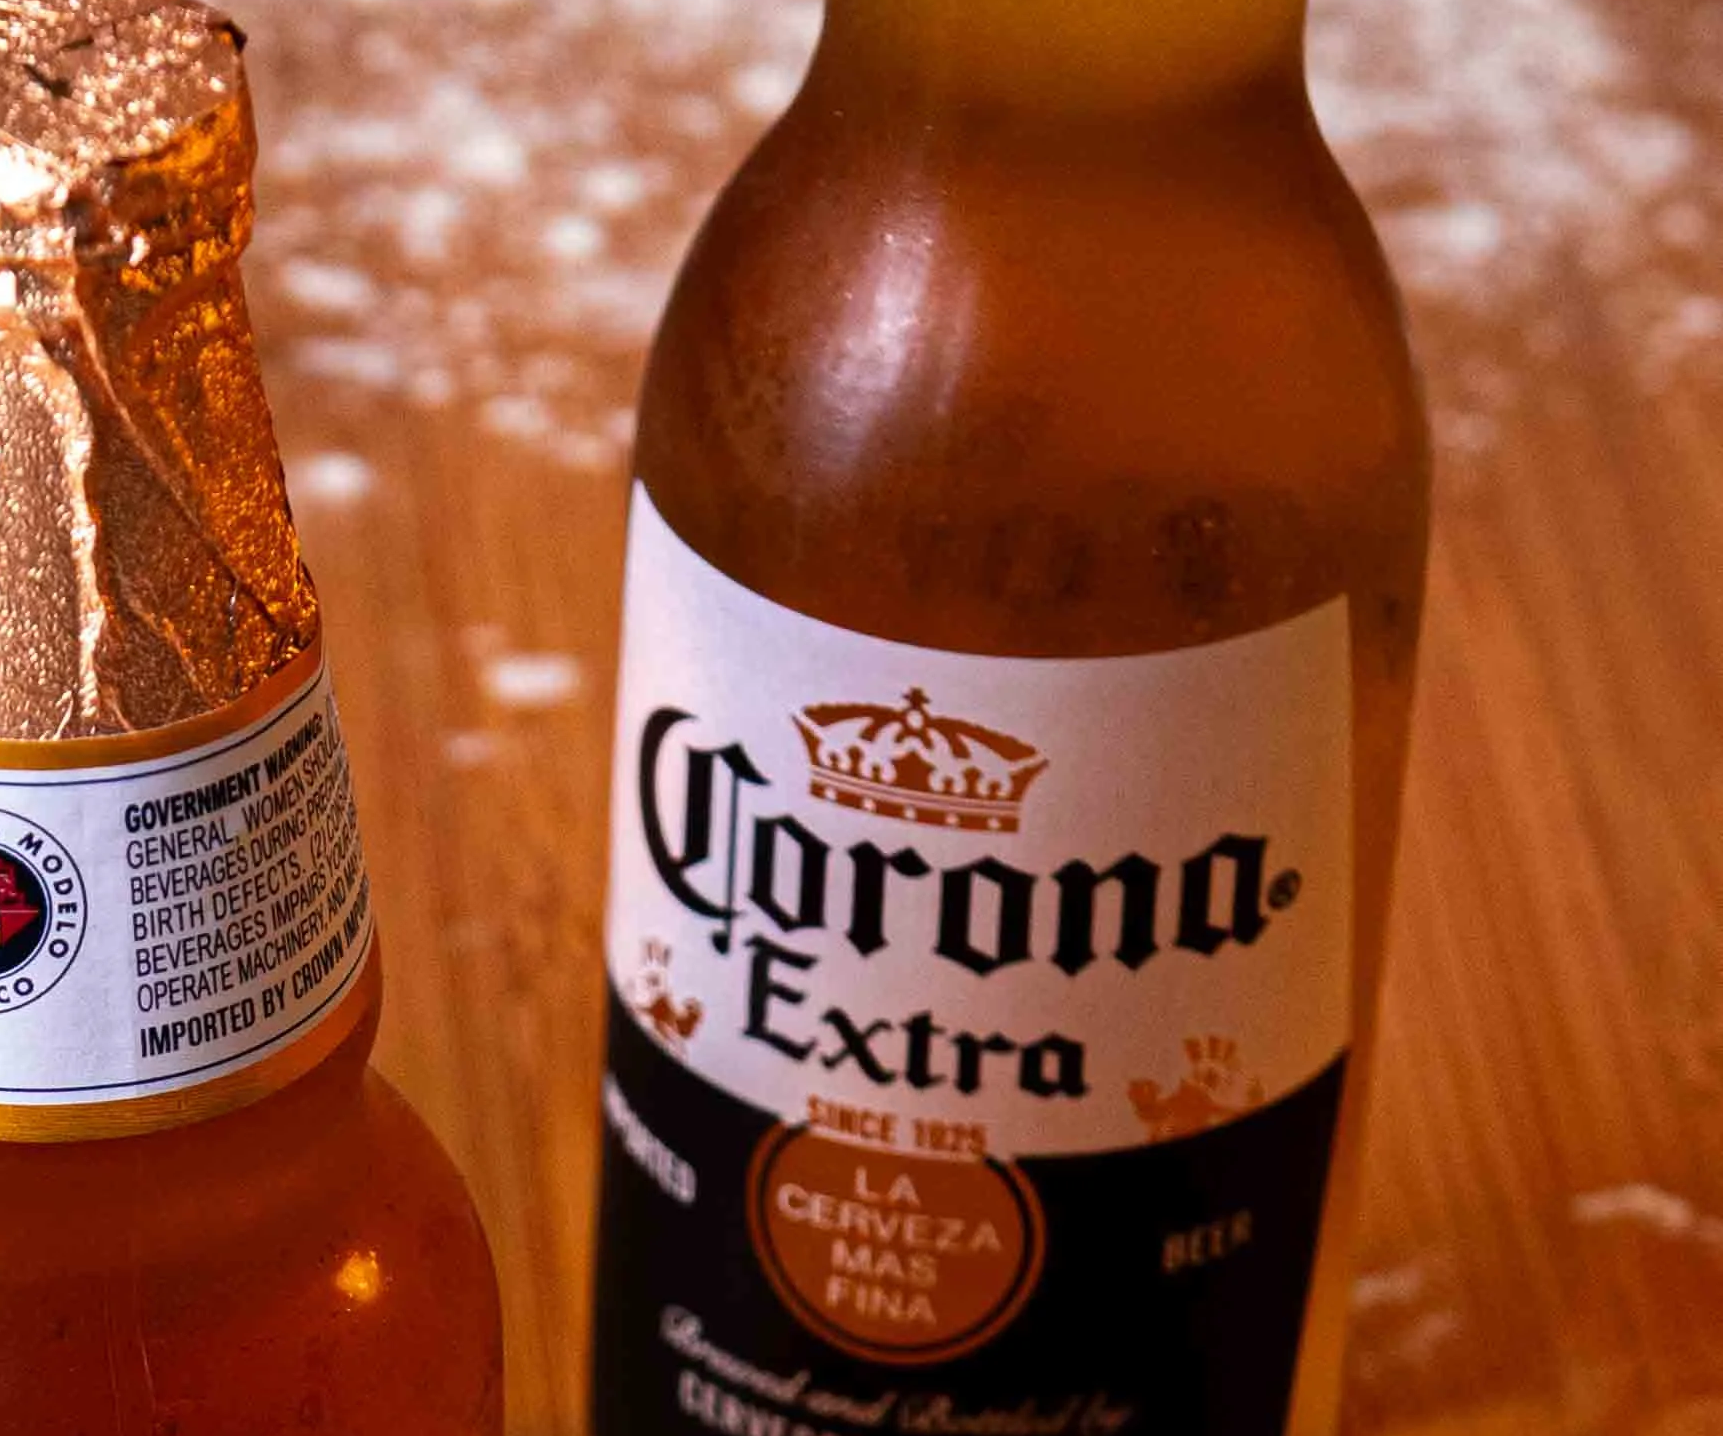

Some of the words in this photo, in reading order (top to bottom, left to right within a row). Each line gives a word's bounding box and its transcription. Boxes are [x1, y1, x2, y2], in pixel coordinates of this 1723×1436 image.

[124, 763, 263, 835] GOVERNMENT
[262, 711, 324, 786] WARNING:
[126, 815, 240, 870] GENERAL,
[241, 779, 306, 834] WOMEN
[130, 846, 249, 907] BEVERAGES
[249, 807, 308, 869] DURING
[17, 831, 79, 960] MODELO
[131, 900, 206, 943] BIRTH
[212, 851, 309, 922] DEFECTS.
[135, 910, 268, 979] BEVERAGES
[270, 862, 328, 931] IMPAIRS
[136, 961, 240, 1014] OPERATE
[238, 915, 329, 985] MACHINERY,
[140, 997, 257, 1059] IMPORTED
[262, 978, 287, 1020] BY
[292, 929, 345, 1002] CROWN
[741, 932, 1091, 1101] Extra
[807, 1095, 898, 1148] SINCE
[776, 1181, 1005, 1253] CERVEZA
[855, 1166, 922, 1206] LA
[831, 1238, 939, 1284] MAS
[1162, 1209, 1254, 1274] BEER
[825, 1275, 939, 1326] FINA
[805, 1390, 898, 1426] and
